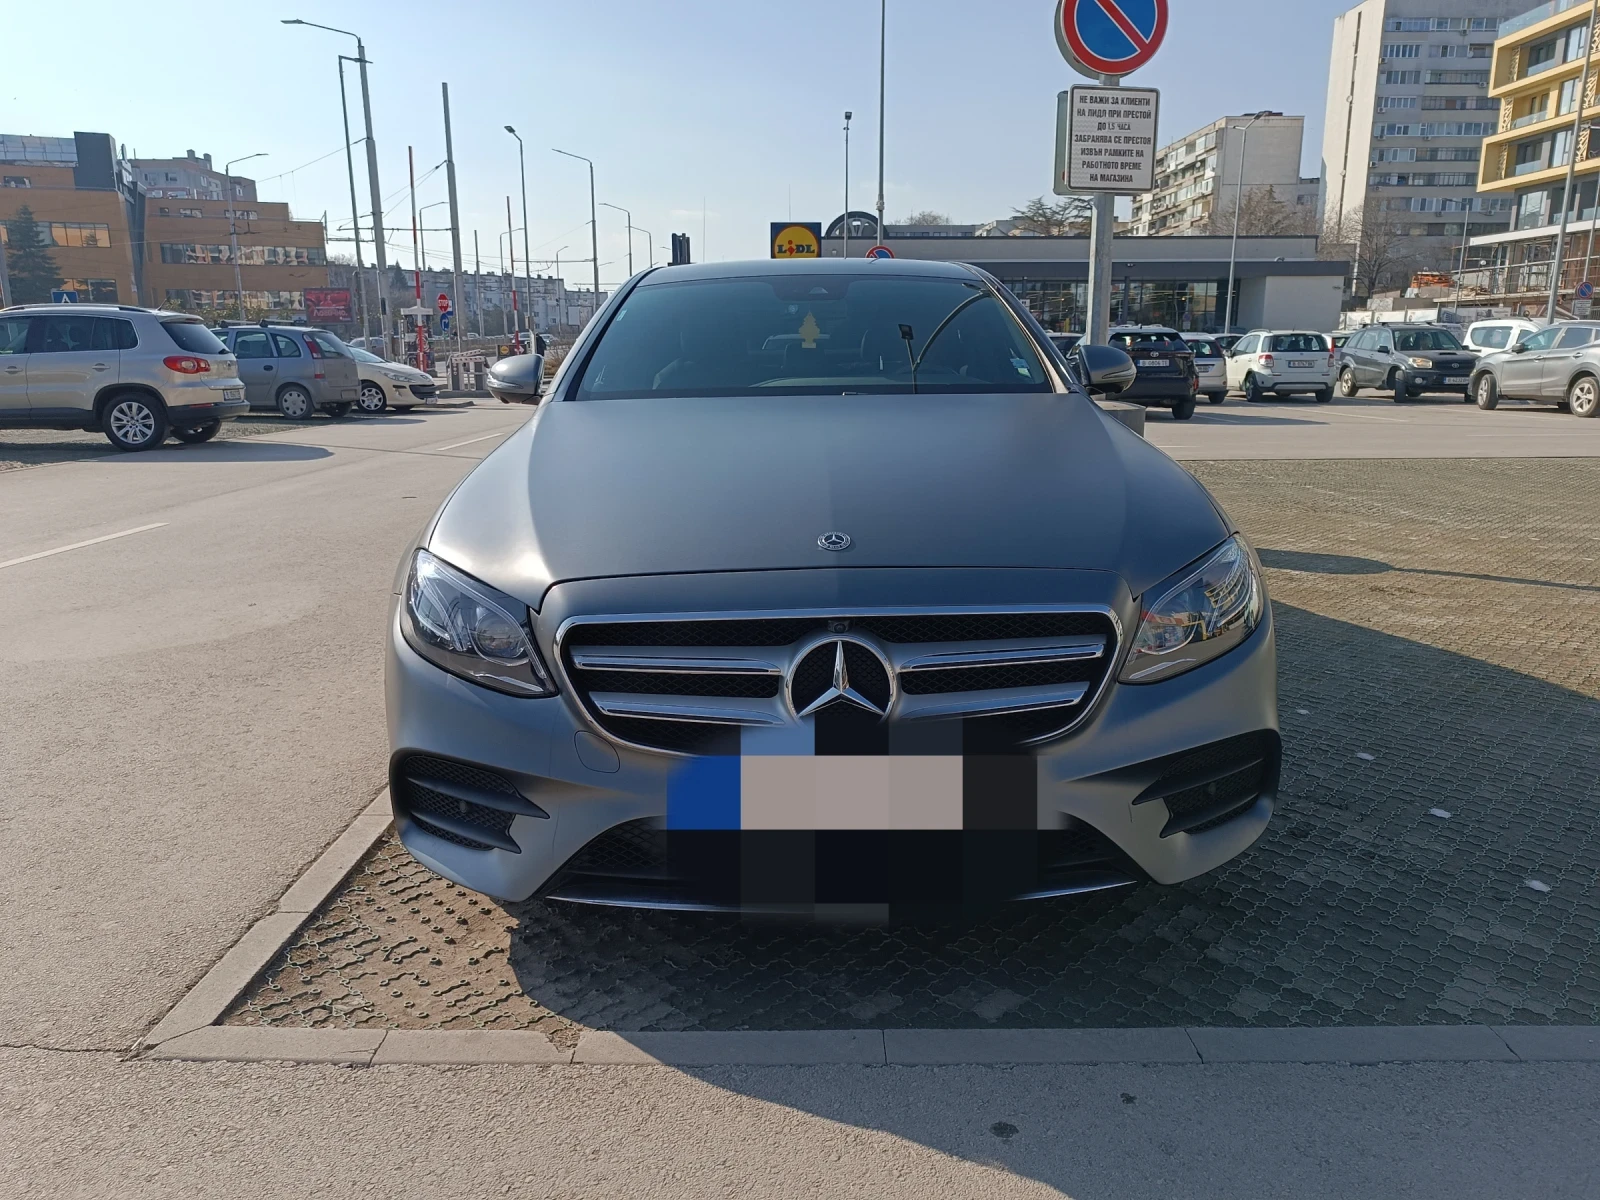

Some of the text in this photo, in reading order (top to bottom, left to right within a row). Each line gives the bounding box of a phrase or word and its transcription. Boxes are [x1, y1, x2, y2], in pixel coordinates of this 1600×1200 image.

[1090, 96, 1109, 104] ВАЖИ
[1121, 97, 1150, 106] КЛИЕНТИ
[1077, 109, 1086, 117] НА
[1088, 109, 1106, 118] ЛИДЛ
[1123, 110, 1151, 119] ПРЕСТОЙ
[1074, 135, 1112, 143] ЗАБРАНЯВА
[1124, 136, 1151, 145] ПРЕСТОЯ
[1104, 149, 1134, 157] РАМКИТЕ
[1082, 161, 1142, 170] РАБОТНОТО ВРЕМЕ
[1100, 174, 1133, 182] МАГАЗИНА
